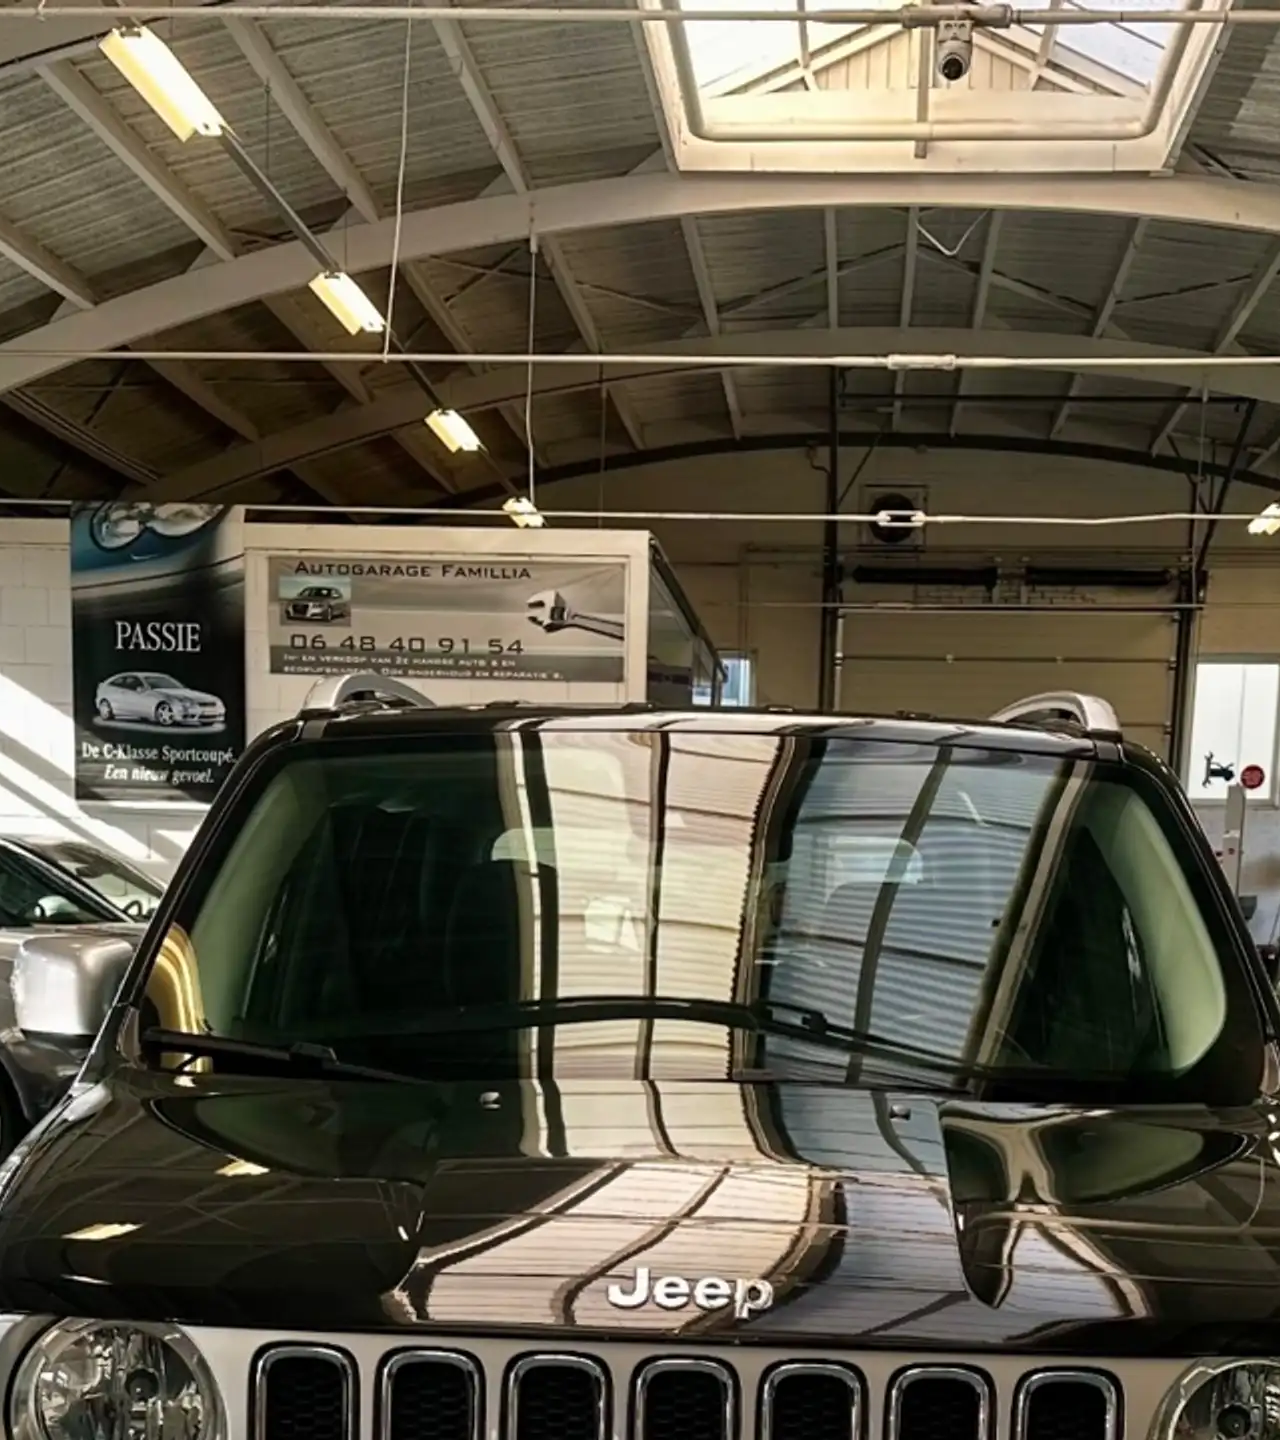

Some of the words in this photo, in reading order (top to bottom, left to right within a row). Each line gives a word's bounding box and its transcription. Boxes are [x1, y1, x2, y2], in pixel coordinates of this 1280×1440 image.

[294, 560, 431, 578] AUTOGARAGE
[115, 620, 202, 652] PASSIE
[290, 633, 326, 651] 06
[340, 635, 376, 652] 48
[389, 636, 425, 653] 40
[439, 637, 469, 654] 91
[488, 639, 524, 655] 54
[82, 742, 100, 758] De
[103, 743, 158, 761] C-Klasse
[104, 764, 128, 781] Een
[607, 1267, 773, 1320] Jeep
